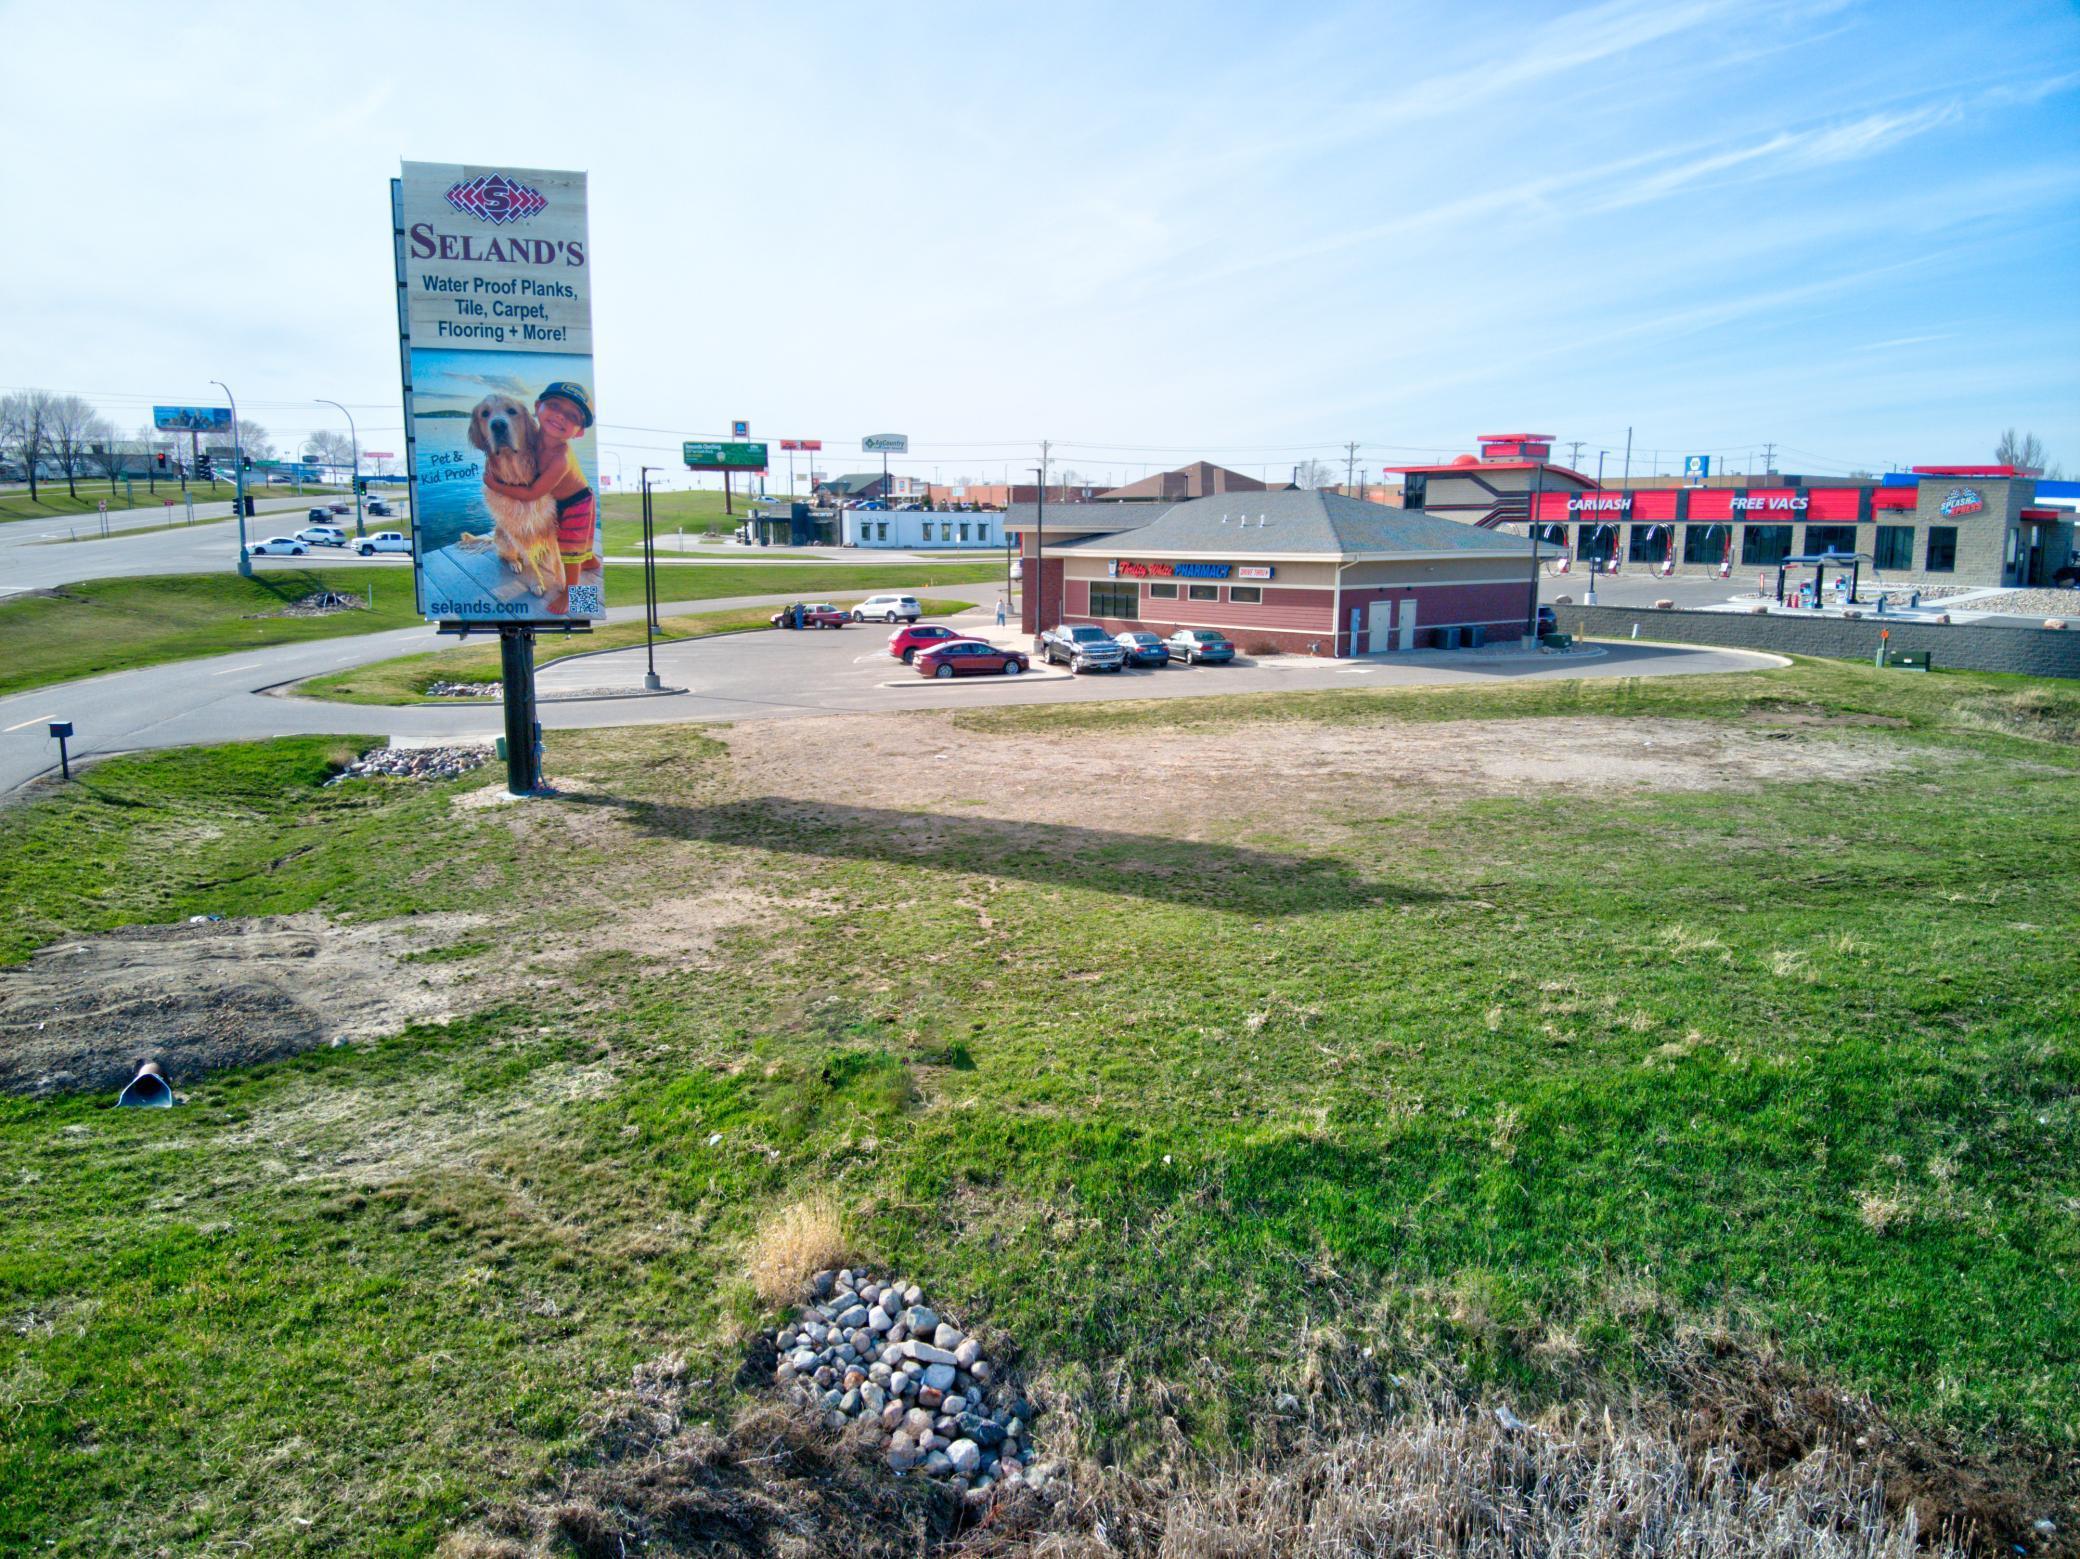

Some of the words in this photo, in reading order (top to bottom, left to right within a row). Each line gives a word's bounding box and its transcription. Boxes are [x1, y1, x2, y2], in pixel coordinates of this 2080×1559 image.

[482, 186, 510, 210] S
[423, 275, 469, 292] Water
[474, 278, 517, 295] Proof
[522, 280, 578, 301] Planks,
[455, 299, 488, 318] Tile,
[493, 301, 548, 321] Carpet,
[439, 321, 504, 342] Flooring
[509, 326, 518, 337] +
[524, 324, 567, 341] More!
[431, 452, 451, 466] Pet
[453, 451, 464, 462] &
[421, 470, 441, 485] Kid
[445, 463, 479, 481] Proof!
[1567, 498, 1632, 511] CARWASH
[1729, 497, 1765, 510] FREE
[1769, 497, 1809, 510] VACS
[1174, 563, 1232, 579] PHARMACY
[431, 598, 529, 614] selands.com
